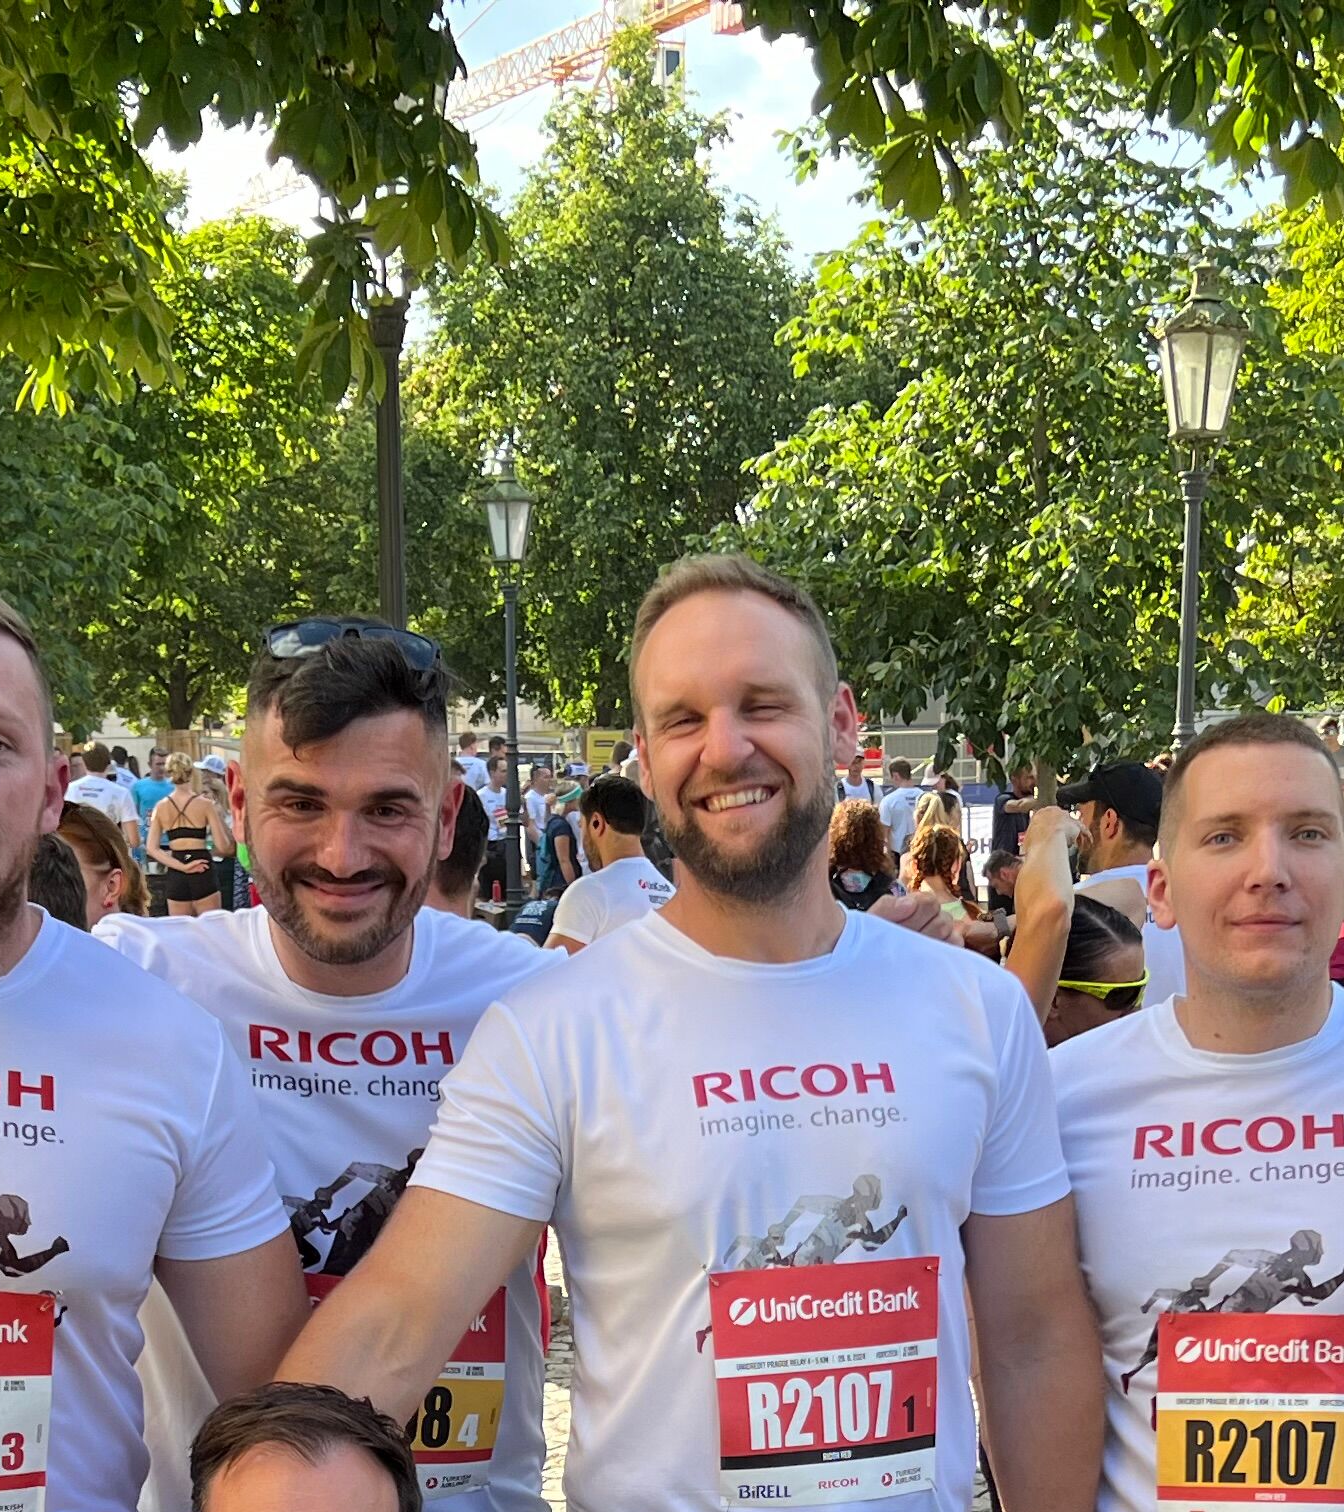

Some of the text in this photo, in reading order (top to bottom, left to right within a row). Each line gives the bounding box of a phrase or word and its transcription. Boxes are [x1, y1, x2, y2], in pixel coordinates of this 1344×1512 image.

[248, 1023, 453, 1066] RICOH
[251, 1068, 441, 1101] imagine. chang
[692, 1062, 896, 1107] RICOH
[699, 1104, 908, 1137] imagine. change.
[1130, 1167, 1240, 1192] imagine.
[759, 1286, 919, 1324] UniCredit Bank
[1203, 1339, 1310, 1364] UniCredit
[747, 1370, 916, 1450] R2107 1
[1, 1432, 25, 1471] 3
[1185, 1419, 1337, 1485] R2107
[818, 1477, 859, 1489] RICOH
